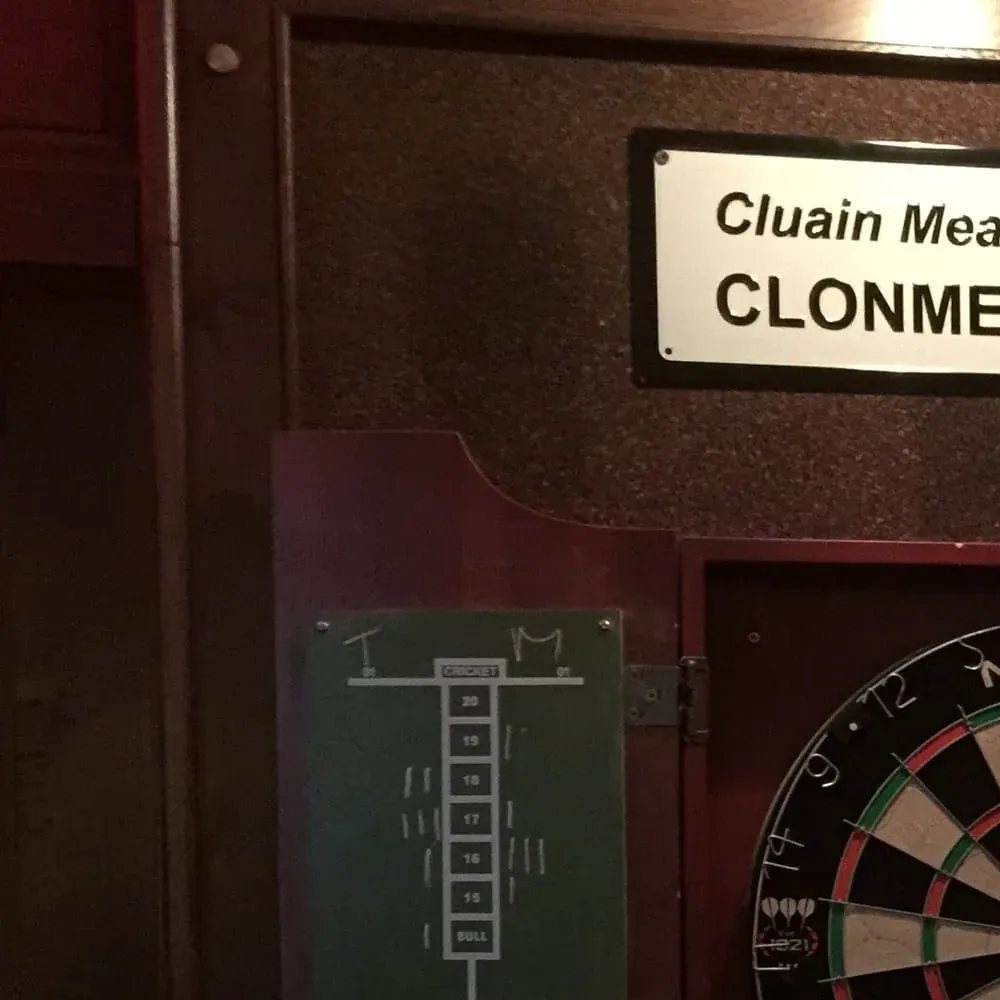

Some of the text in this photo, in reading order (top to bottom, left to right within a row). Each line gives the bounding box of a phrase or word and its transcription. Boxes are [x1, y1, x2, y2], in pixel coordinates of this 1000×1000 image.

[716, 191, 882, 242] Cluain
[443, 665, 499, 678] CRICKET
[463, 735, 480, 747] 19
[463, 774, 480, 786] 18
[463, 813, 480, 825] 17
[463, 853, 480, 865] 16
[463, 892, 480, 904] 15
[457, 930, 488, 942] BULL
